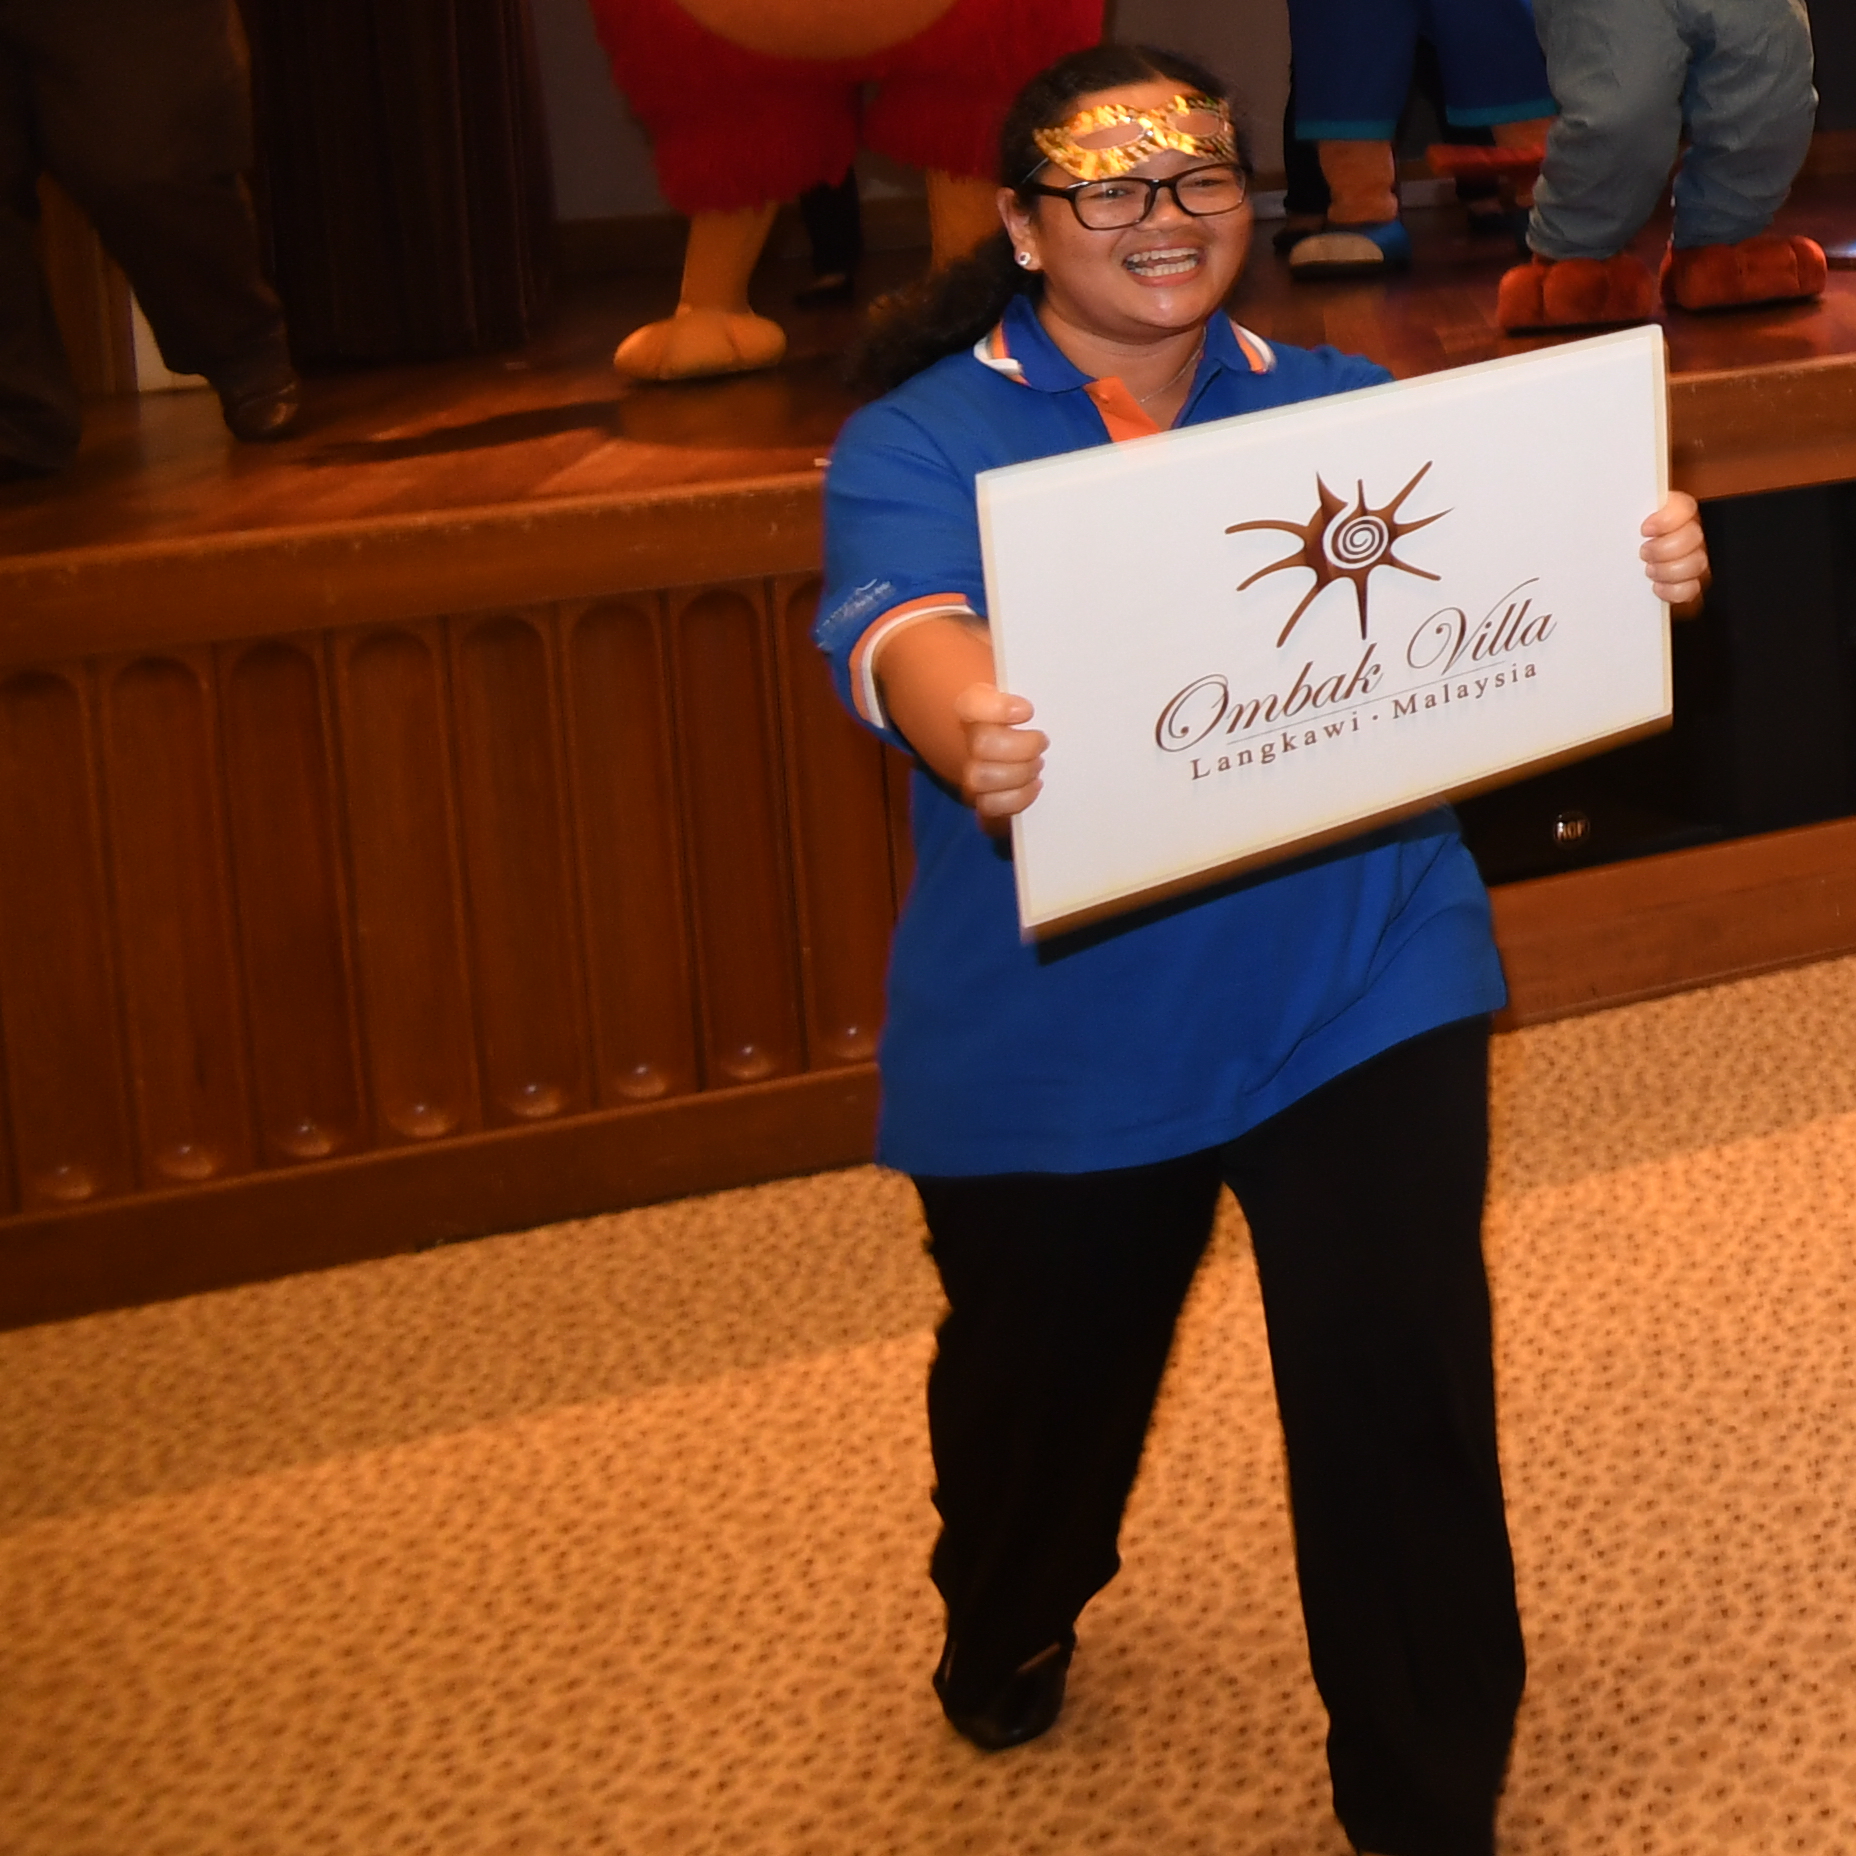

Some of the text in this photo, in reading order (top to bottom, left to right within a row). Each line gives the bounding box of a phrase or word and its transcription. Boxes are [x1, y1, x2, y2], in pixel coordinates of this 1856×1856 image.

[1154, 576, 1558, 754] Ombak Villa
[1189, 660, 1541, 782] Langkawi Malaysia
